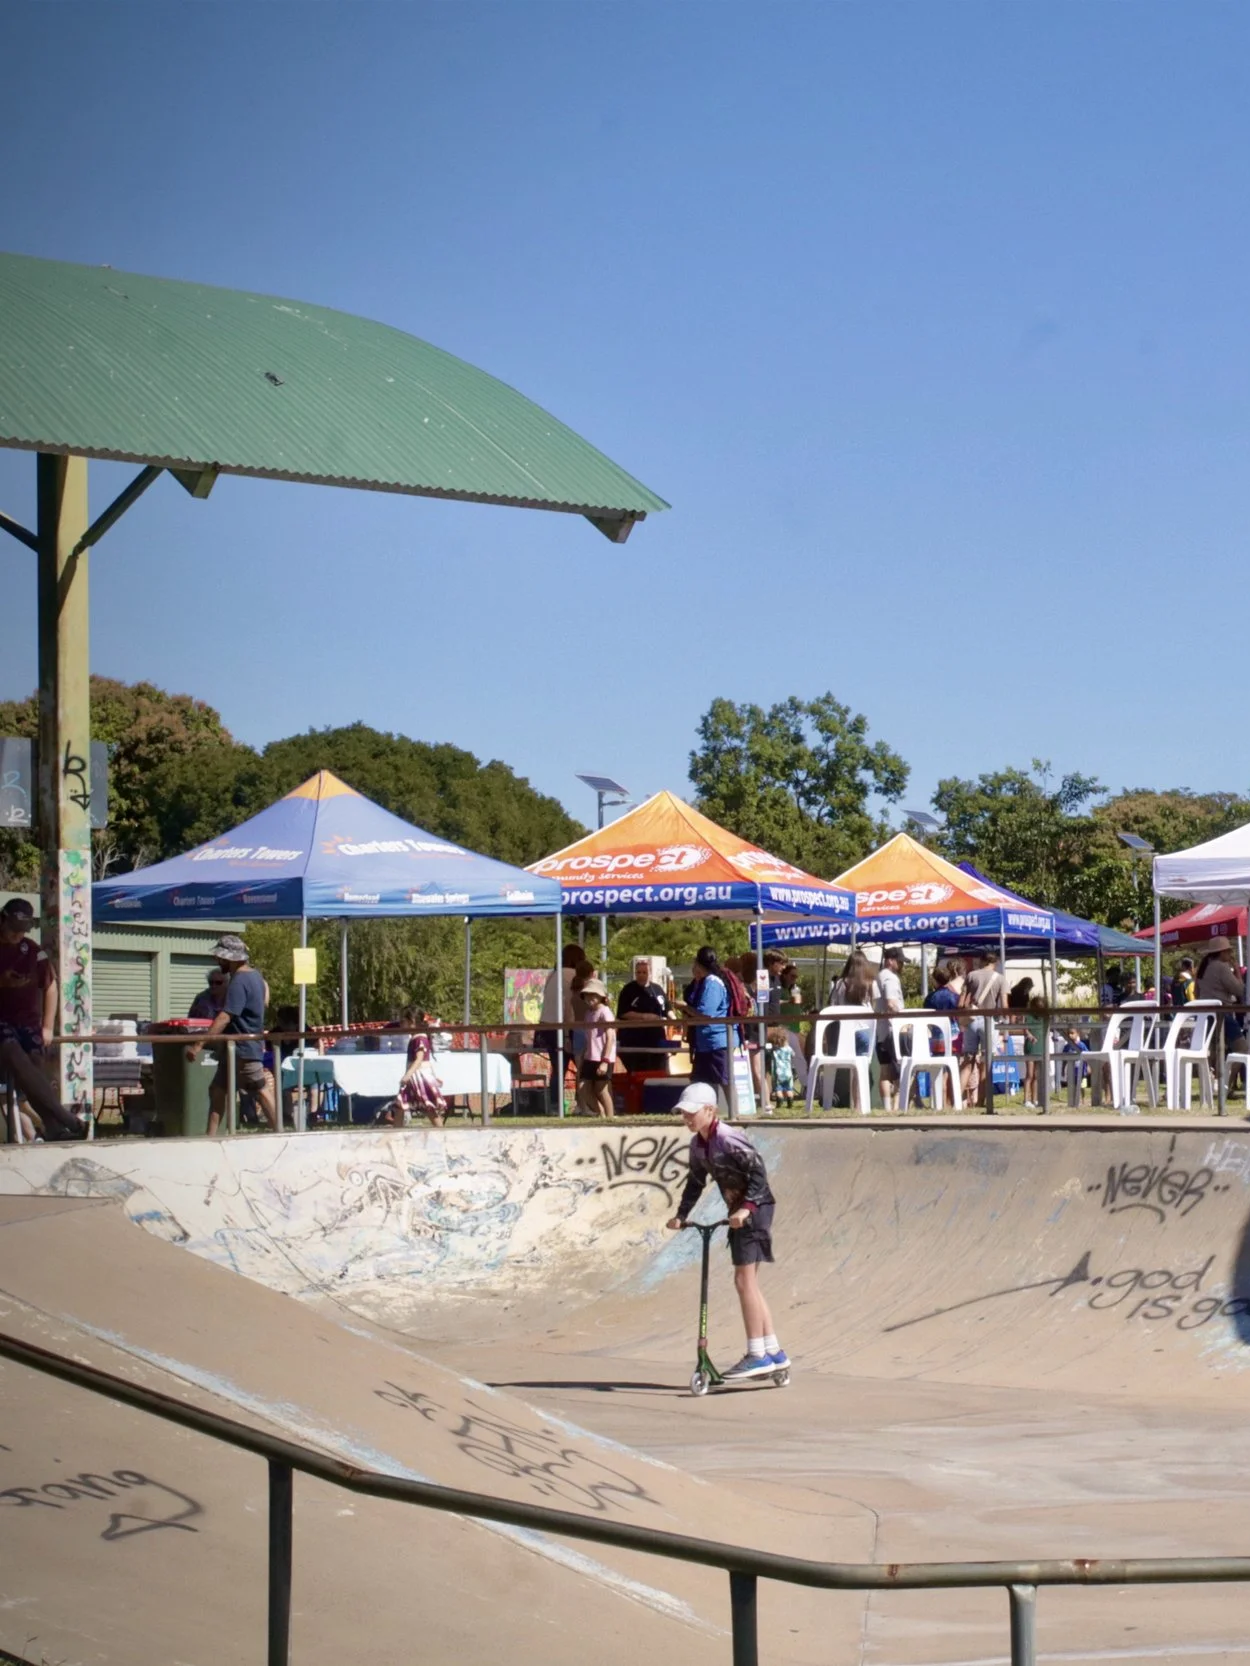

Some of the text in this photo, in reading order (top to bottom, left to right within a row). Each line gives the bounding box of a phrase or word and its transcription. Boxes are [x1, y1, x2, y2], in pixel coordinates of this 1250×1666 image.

[193, 846, 304, 861] Charters Towers
[599, 871, 644, 881] services
[775, 914, 979, 940] www.prospect.org.au
